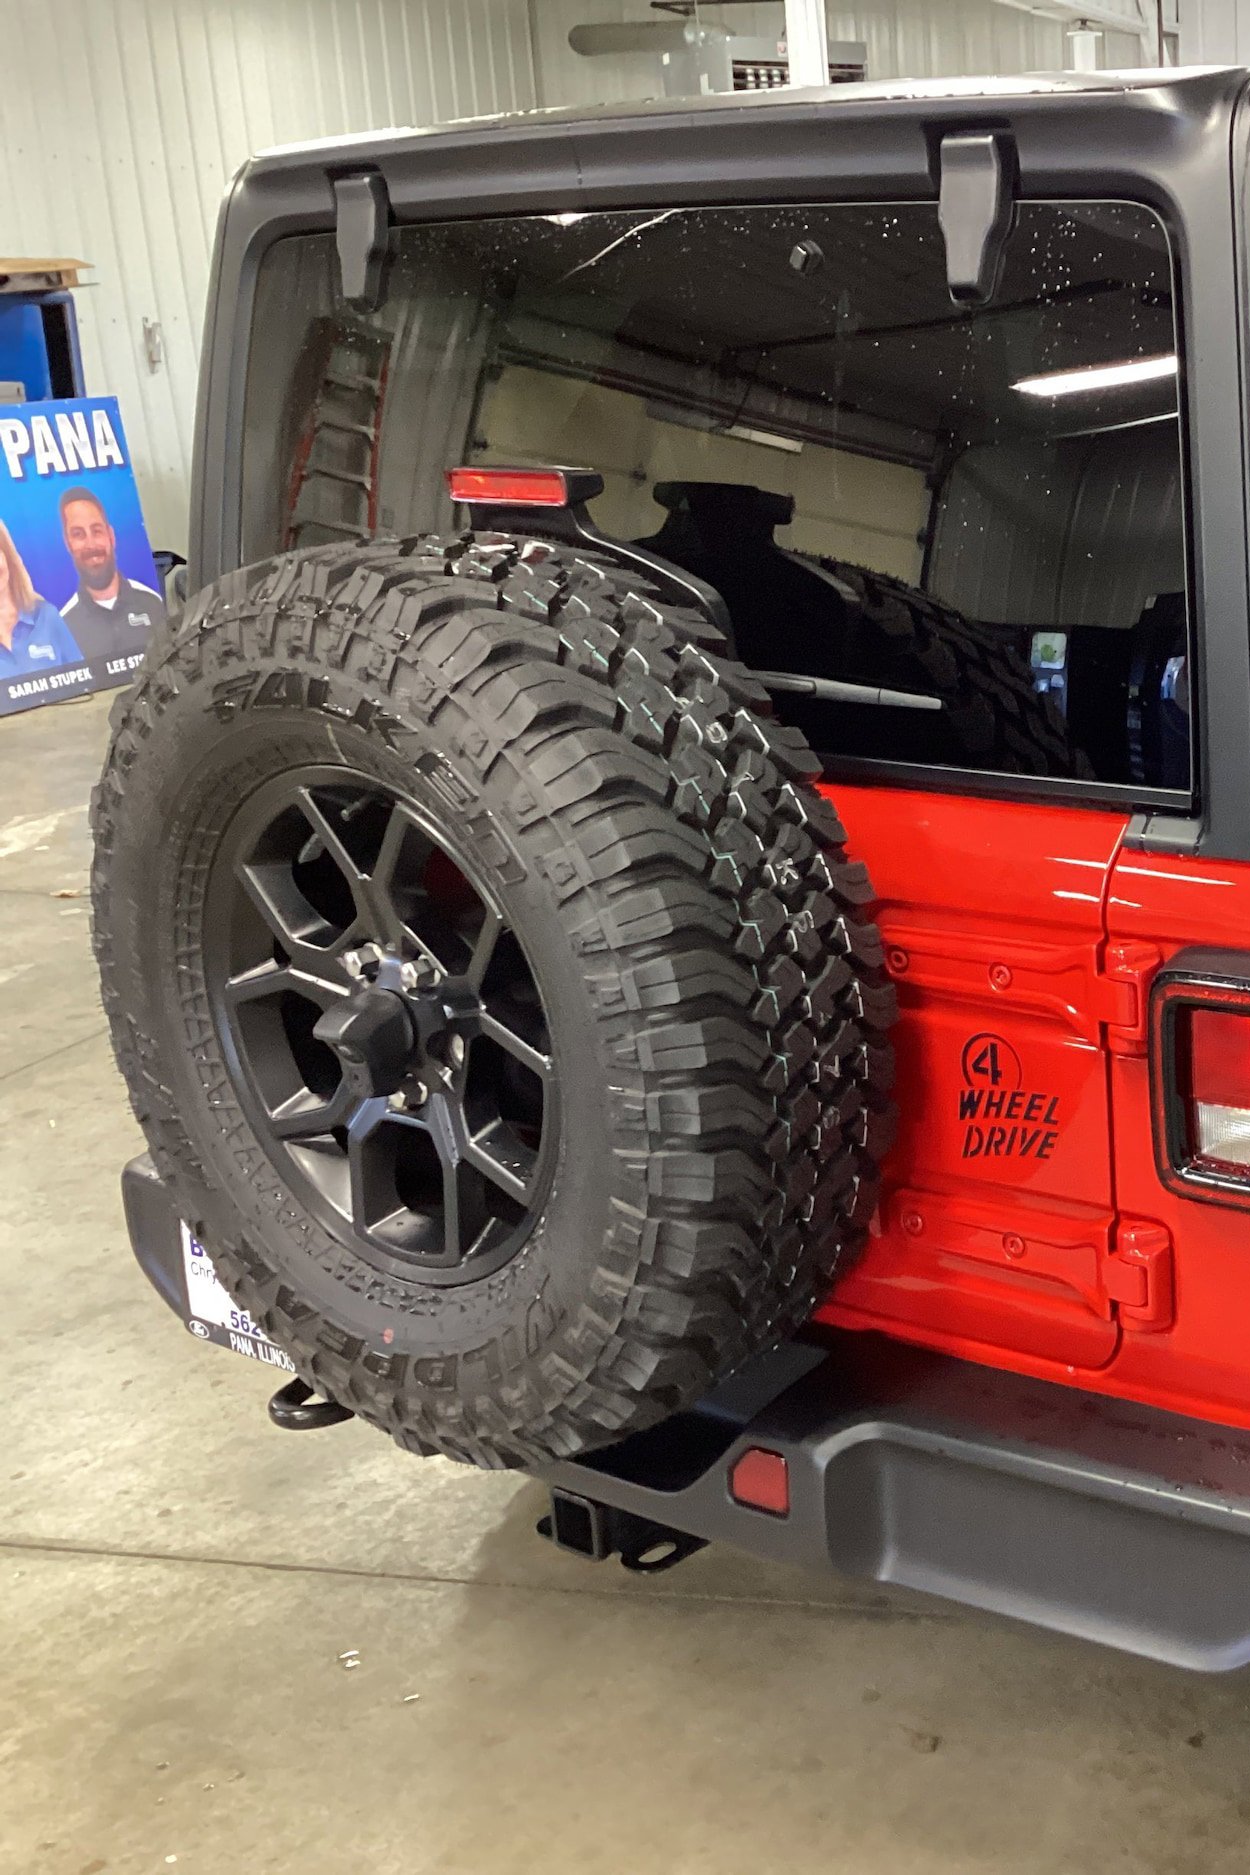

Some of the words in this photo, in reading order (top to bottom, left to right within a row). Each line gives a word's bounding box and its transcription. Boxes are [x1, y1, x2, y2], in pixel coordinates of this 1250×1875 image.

[0, 409, 124, 478] PANA
[8, 678, 49, 699] SARAH
[49, 667, 93, 689] STUPEK
[106, 658, 127, 675] LEE
[971, 1042, 1002, 1086] 4
[959, 1088, 1060, 1125] WHEEL
[962, 1124, 1060, 1159] DRIVE
